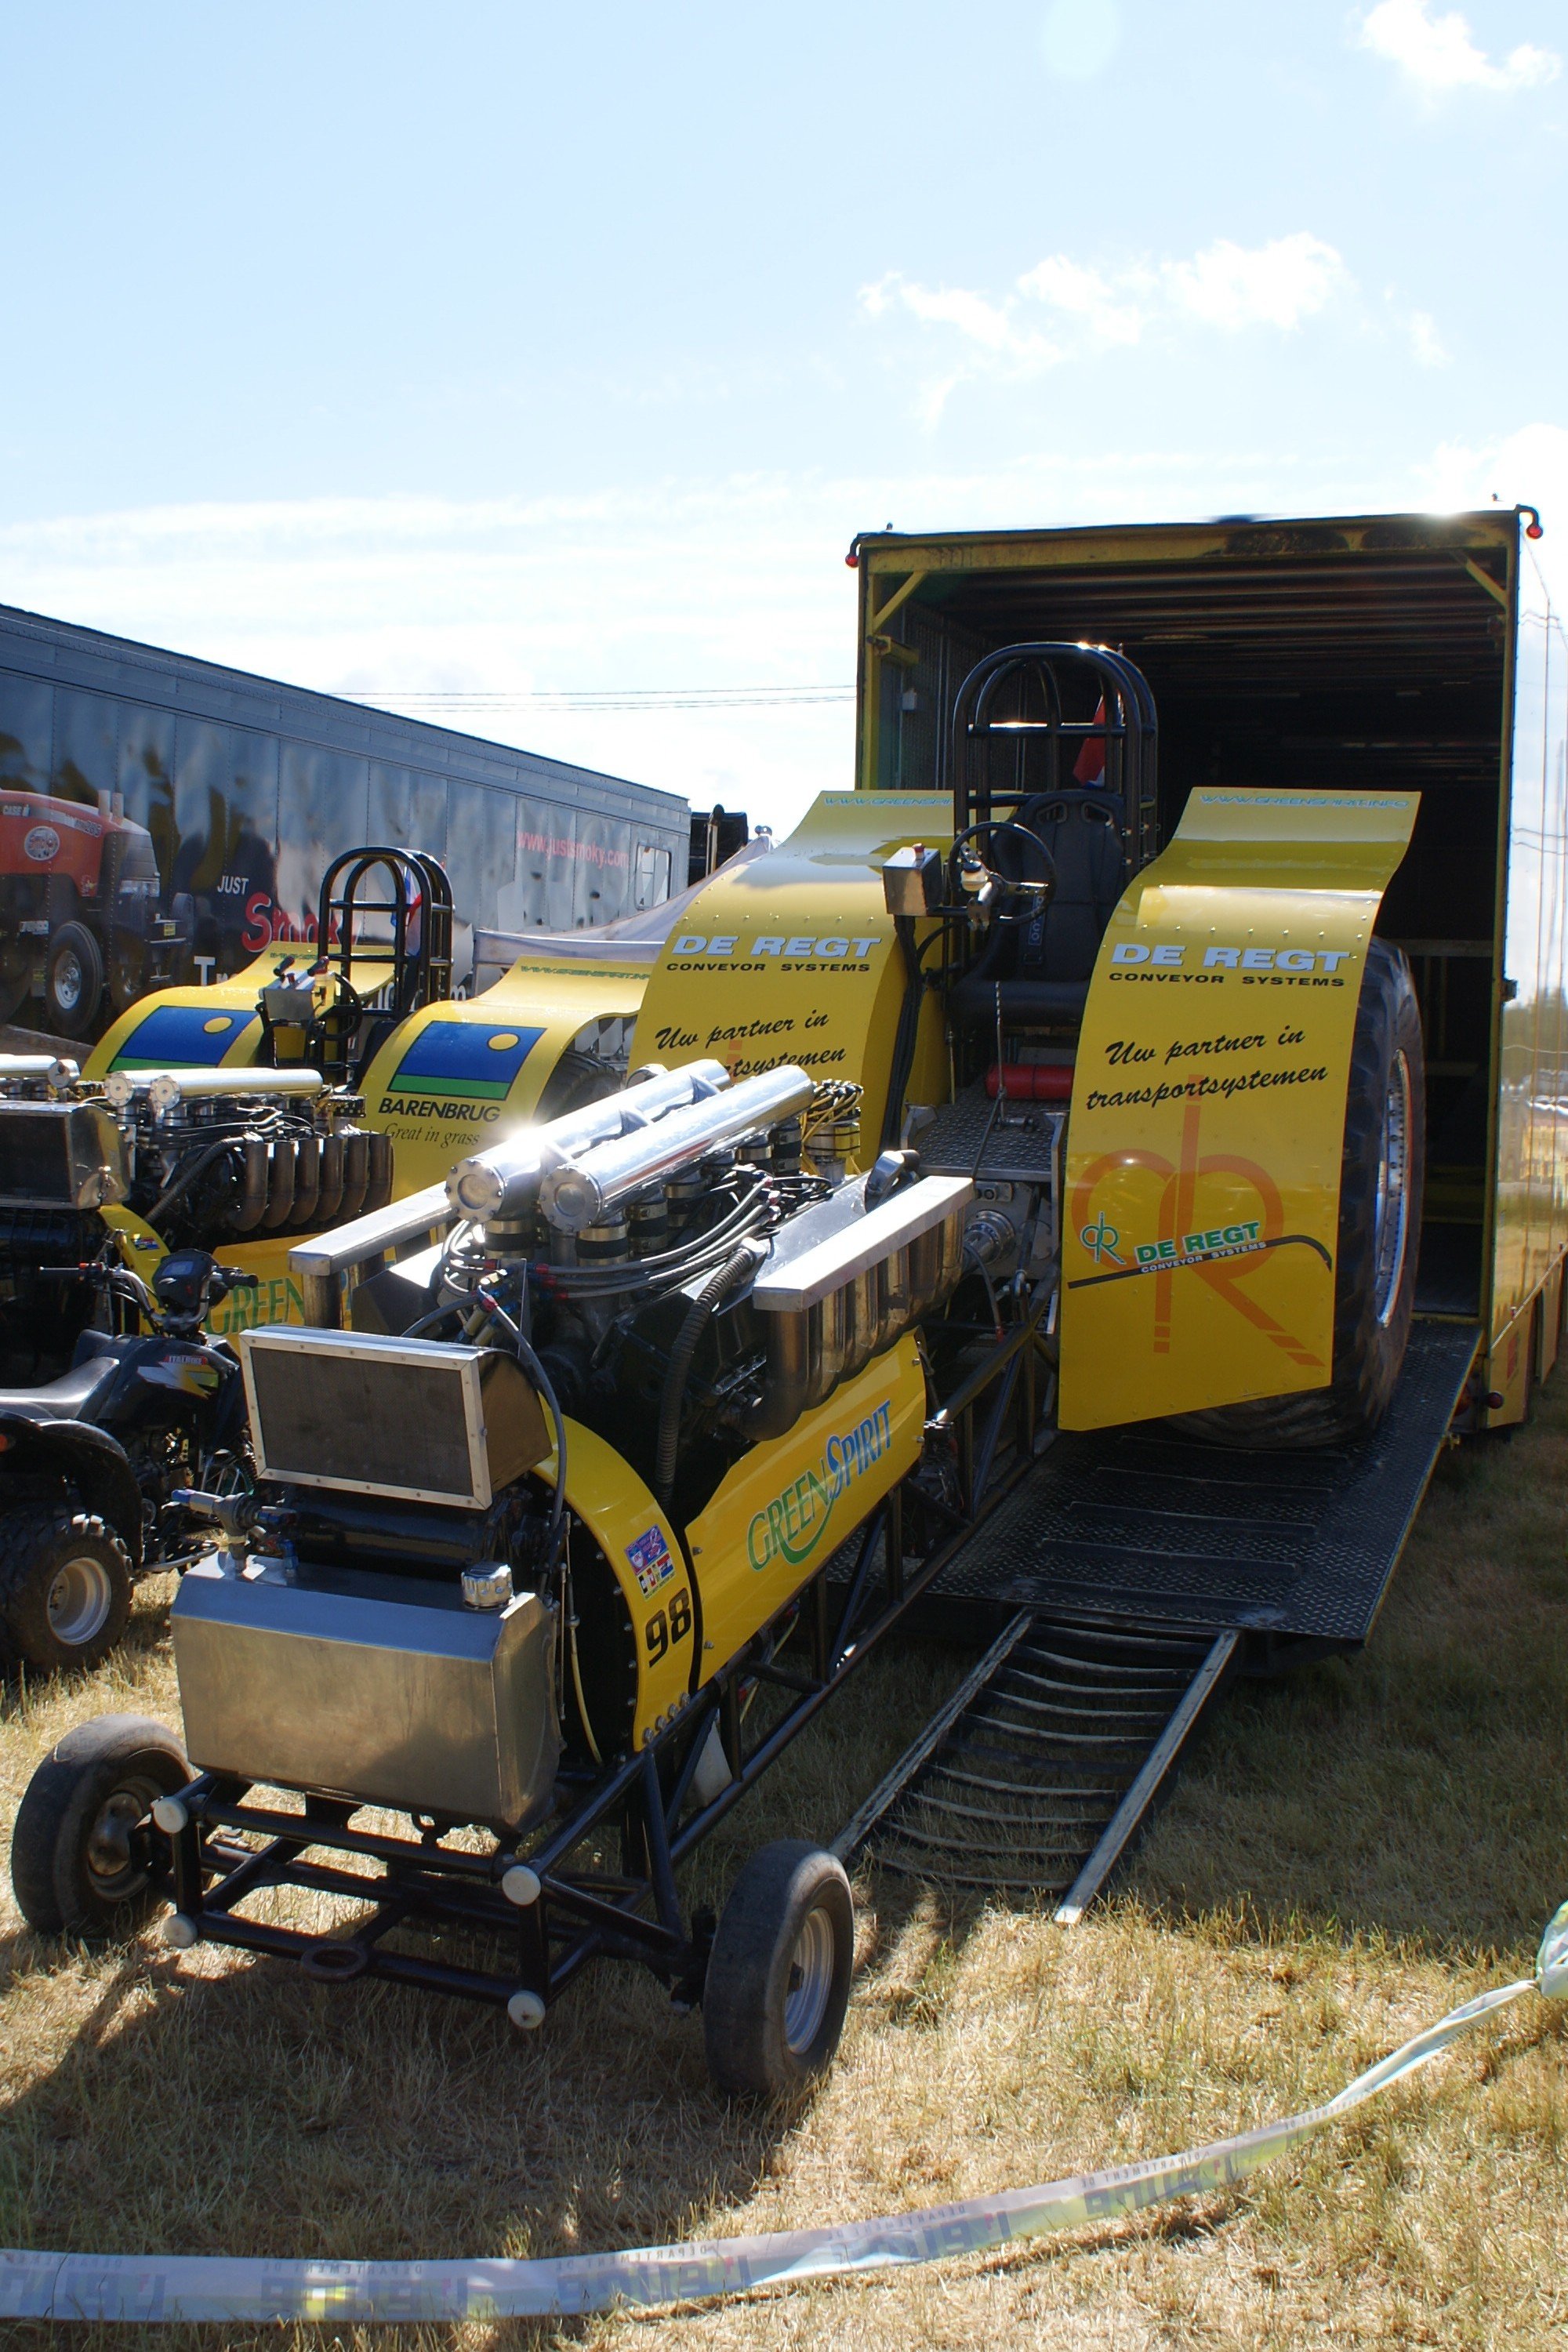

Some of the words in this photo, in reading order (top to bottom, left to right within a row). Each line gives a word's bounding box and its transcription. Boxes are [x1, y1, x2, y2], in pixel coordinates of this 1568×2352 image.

[216, 874, 249, 895] JUST
[672, 935, 740, 956] DE
[750, 936, 882, 958] REGT
[1111, 943, 1186, 967] DE
[1203, 946, 1352, 972] REGT
[666, 963, 766, 971] CONVEYOR
[781, 963, 870, 972] SYSTEMS
[1109, 972, 1225, 984] CONVEYOR
[1242, 976, 1345, 987] SYSTEMS
[655, 1026, 698, 1051] Uw
[706, 1018, 796, 1049] partner
[804, 1009, 829, 1029] in
[1105, 1040, 1156, 1065] Uw
[1165, 1033, 1267, 1065] partner
[1278, 1025, 1306, 1044] in
[1086, 1066, 1328, 1110] transportsystemen
[378, 1098, 501, 1123] BARENBRUG
[384, 1123, 422, 1142] Great
[424, 1126, 438, 1142] in
[440, 1132, 481, 1149] grass
[1135, 1240, 1178, 1265] DE
[1183, 1221, 1261, 1254] REGT
[1141, 1255, 1203, 1273] CONVEYOR
[1211, 1241, 1268, 1259] SYSTEMS
[645, 1587, 692, 1668] 98
